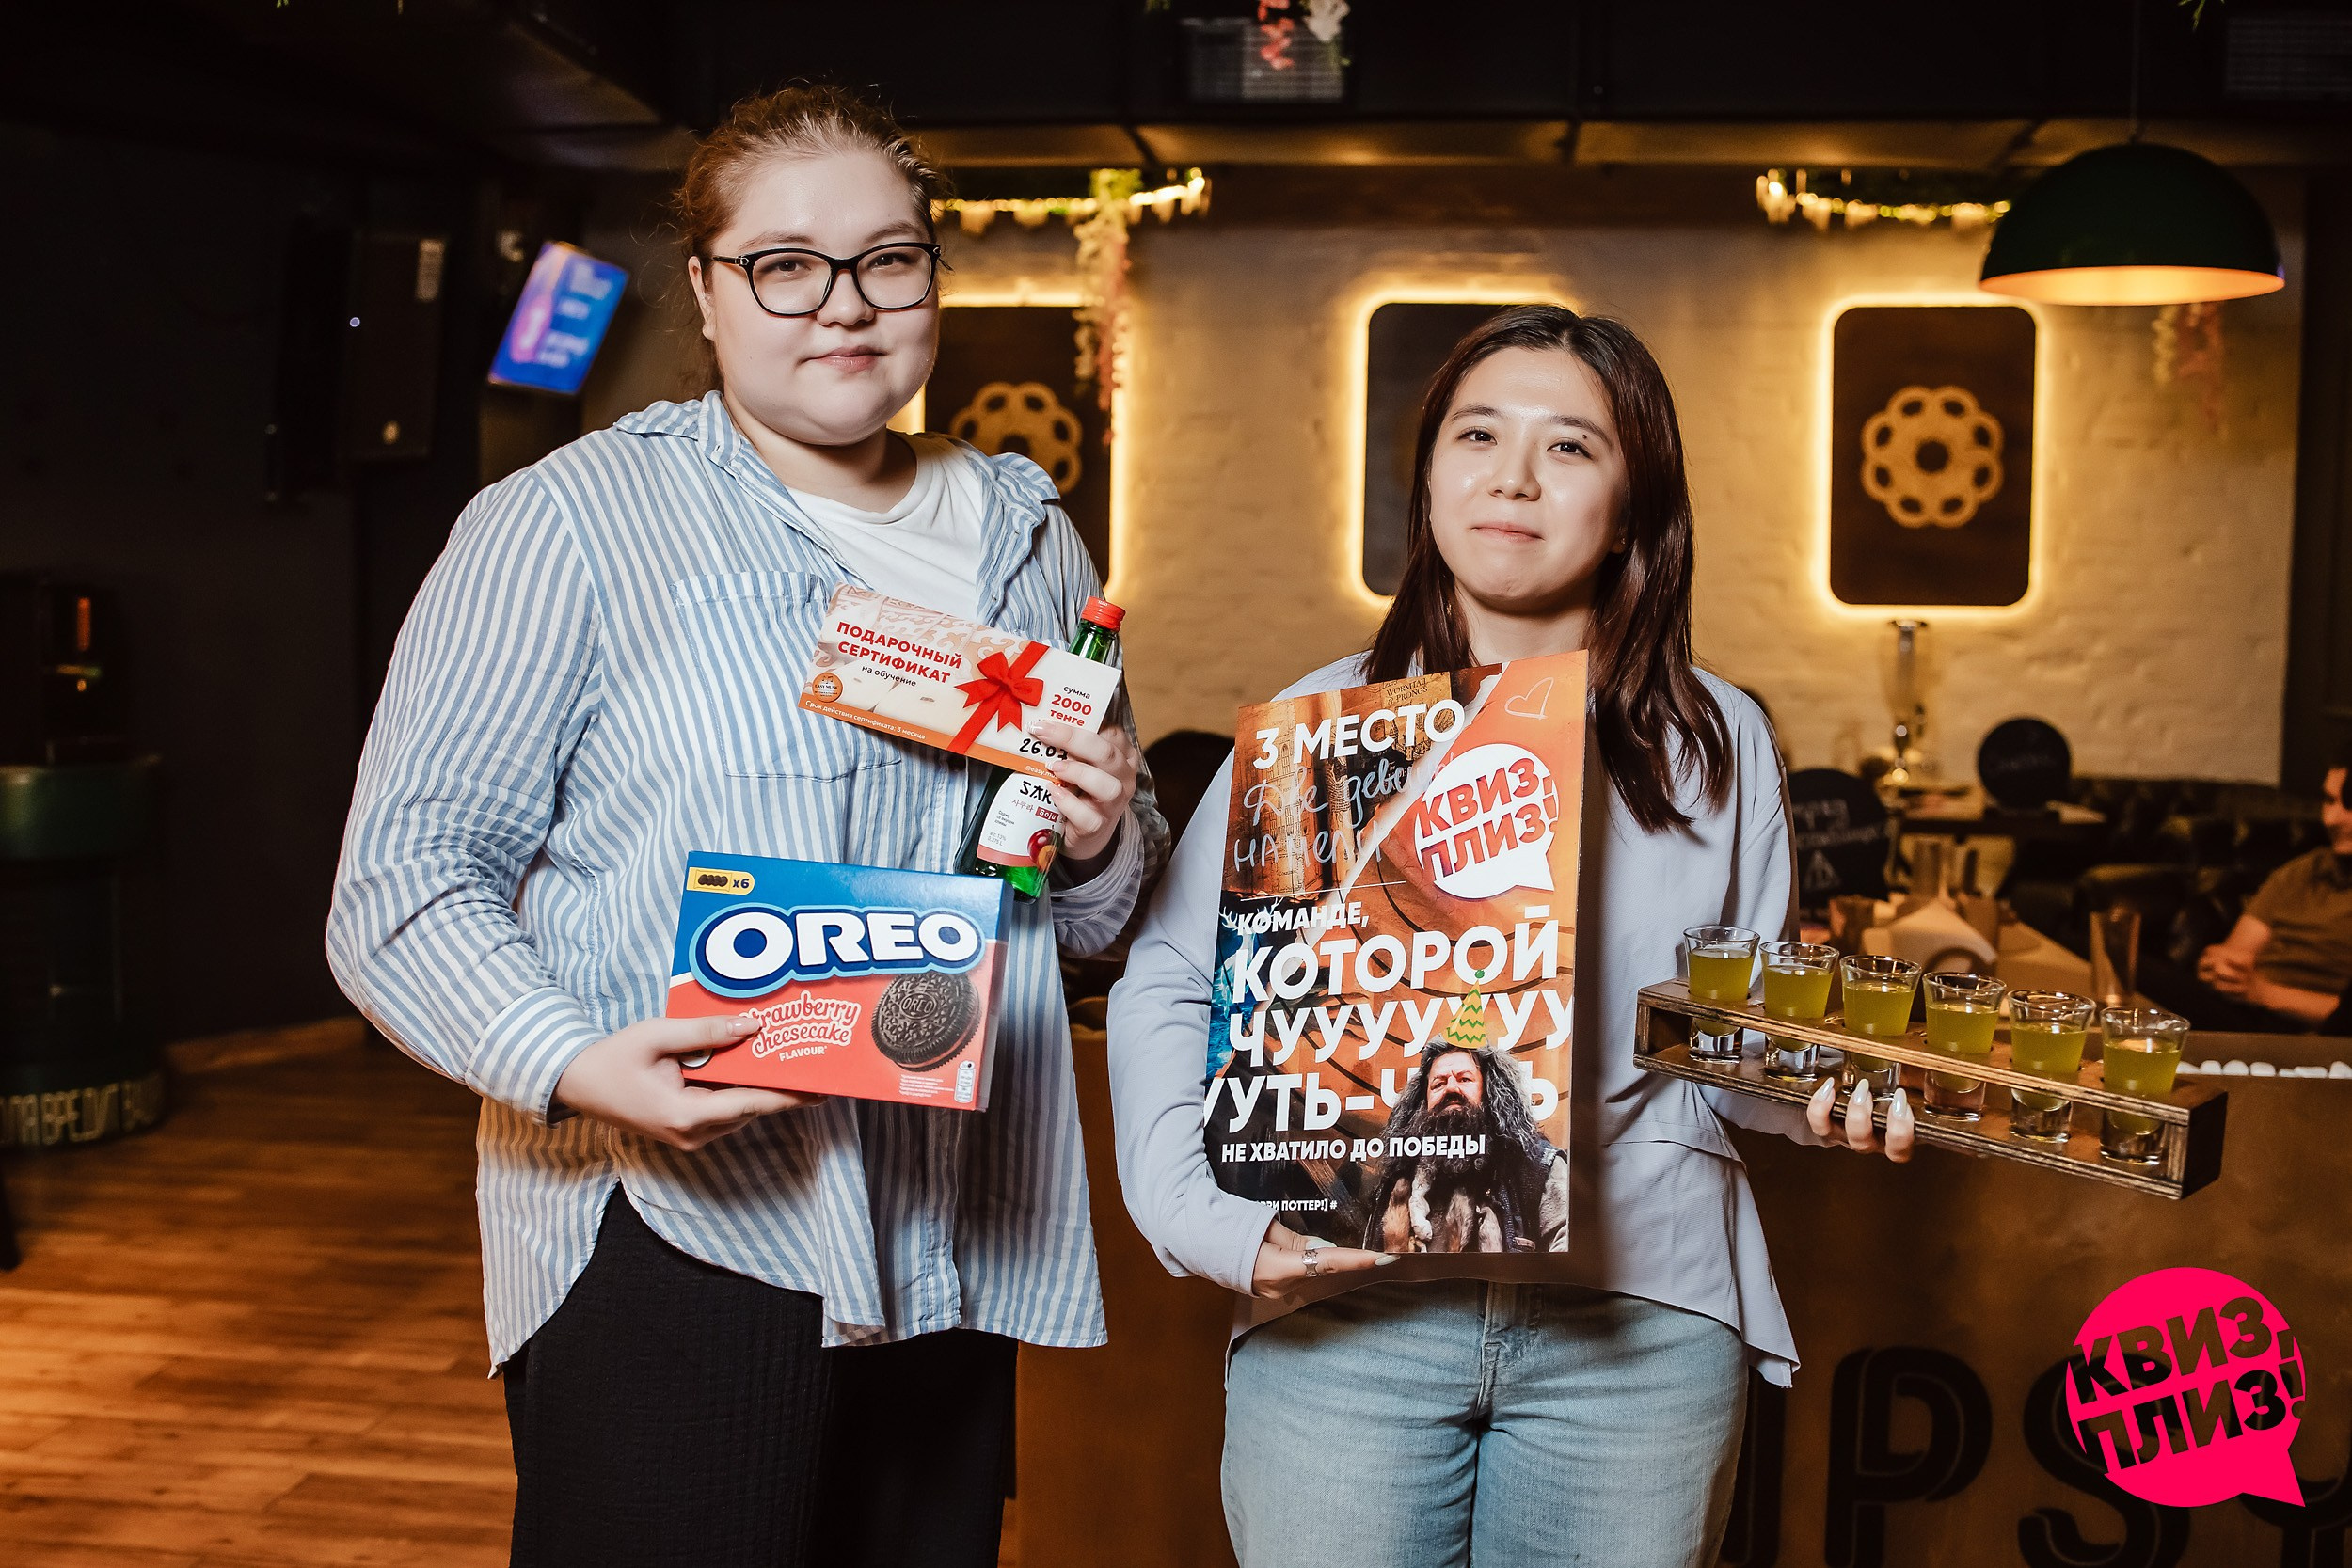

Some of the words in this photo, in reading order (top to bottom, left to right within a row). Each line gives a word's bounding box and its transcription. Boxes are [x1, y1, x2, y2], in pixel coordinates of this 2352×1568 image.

[836, 621, 962, 669] ПОДАРОЧНЫЙ
[837, 641, 951, 684] СЕРТИФИКАТ
[862, 665, 872, 673] на
[874, 668, 917, 688] обучение
[1051, 694, 1092, 715] 2000
[1063, 686, 1090, 700] сумма
[1396, 687, 1428, 702] PRONGS
[805, 700, 822, 709] Срок
[822, 707, 853, 719] действия
[853, 714, 897, 732] сертификата:
[901, 730, 926, 740] месяца
[1050, 709, 1085, 727] тенге
[1253, 728, 1279, 769] 3
[1293, 699, 1466, 764] МЕСТО
[1020, 780, 1057, 807] SAK
[1243, 766, 1329, 827] Две
[1039, 809, 1057, 820] Soju
[1421, 793, 1558, 880] ПЛИЗ!
[733, 879, 750, 889] x6
[1236, 902, 1370, 935] КОМАНДЕ,
[706, 912, 978, 980] OREO
[1233, 905, 1560, 1004] КОТОРОЙ
[903, 997, 933, 1014] OREO
[755, 1023, 850, 1054] cheesecake
[1222, 1143, 1247, 1163] НЕ
[1249, 1138, 1346, 1162] ХВАТИЛО
[1349, 1136, 1384, 1163] ДО
[1390, 1134, 1486, 1159] ПОБЕДЫ
[1281, 1198, 1327, 1212] ПОТТЕР!]
